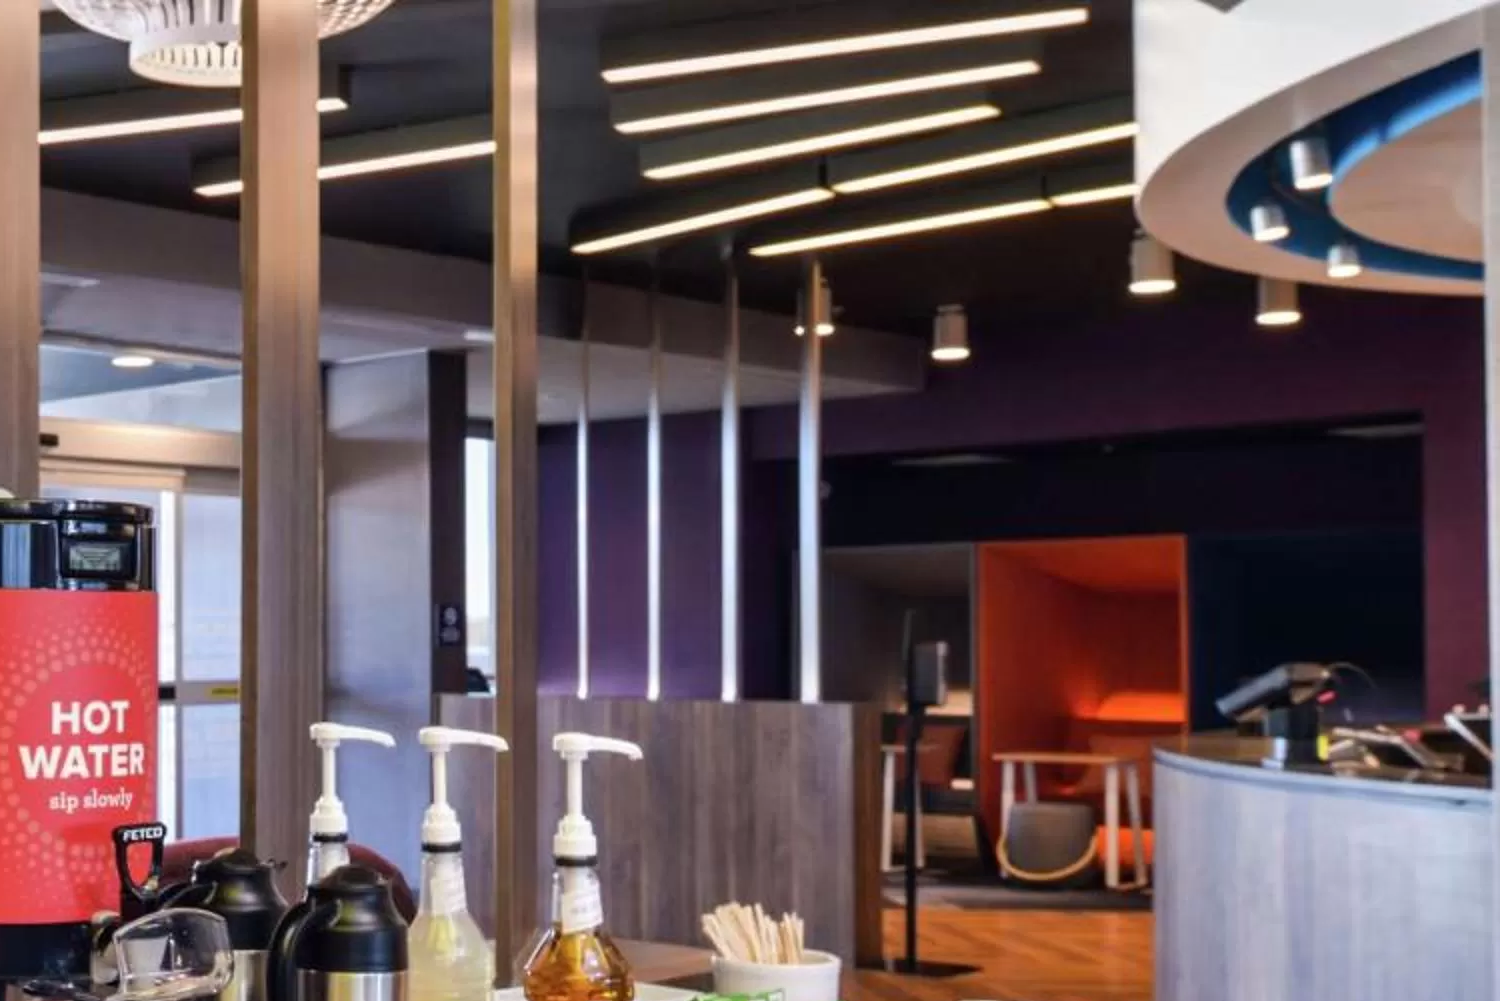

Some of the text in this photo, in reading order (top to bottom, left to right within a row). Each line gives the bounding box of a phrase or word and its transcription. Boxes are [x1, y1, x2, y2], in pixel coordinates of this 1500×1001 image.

[51, 700, 130, 735] HOT
[18, 742, 145, 779] WATER
[49, 787, 133, 814] sip slowly
[123, 826, 163, 841] FETCO
